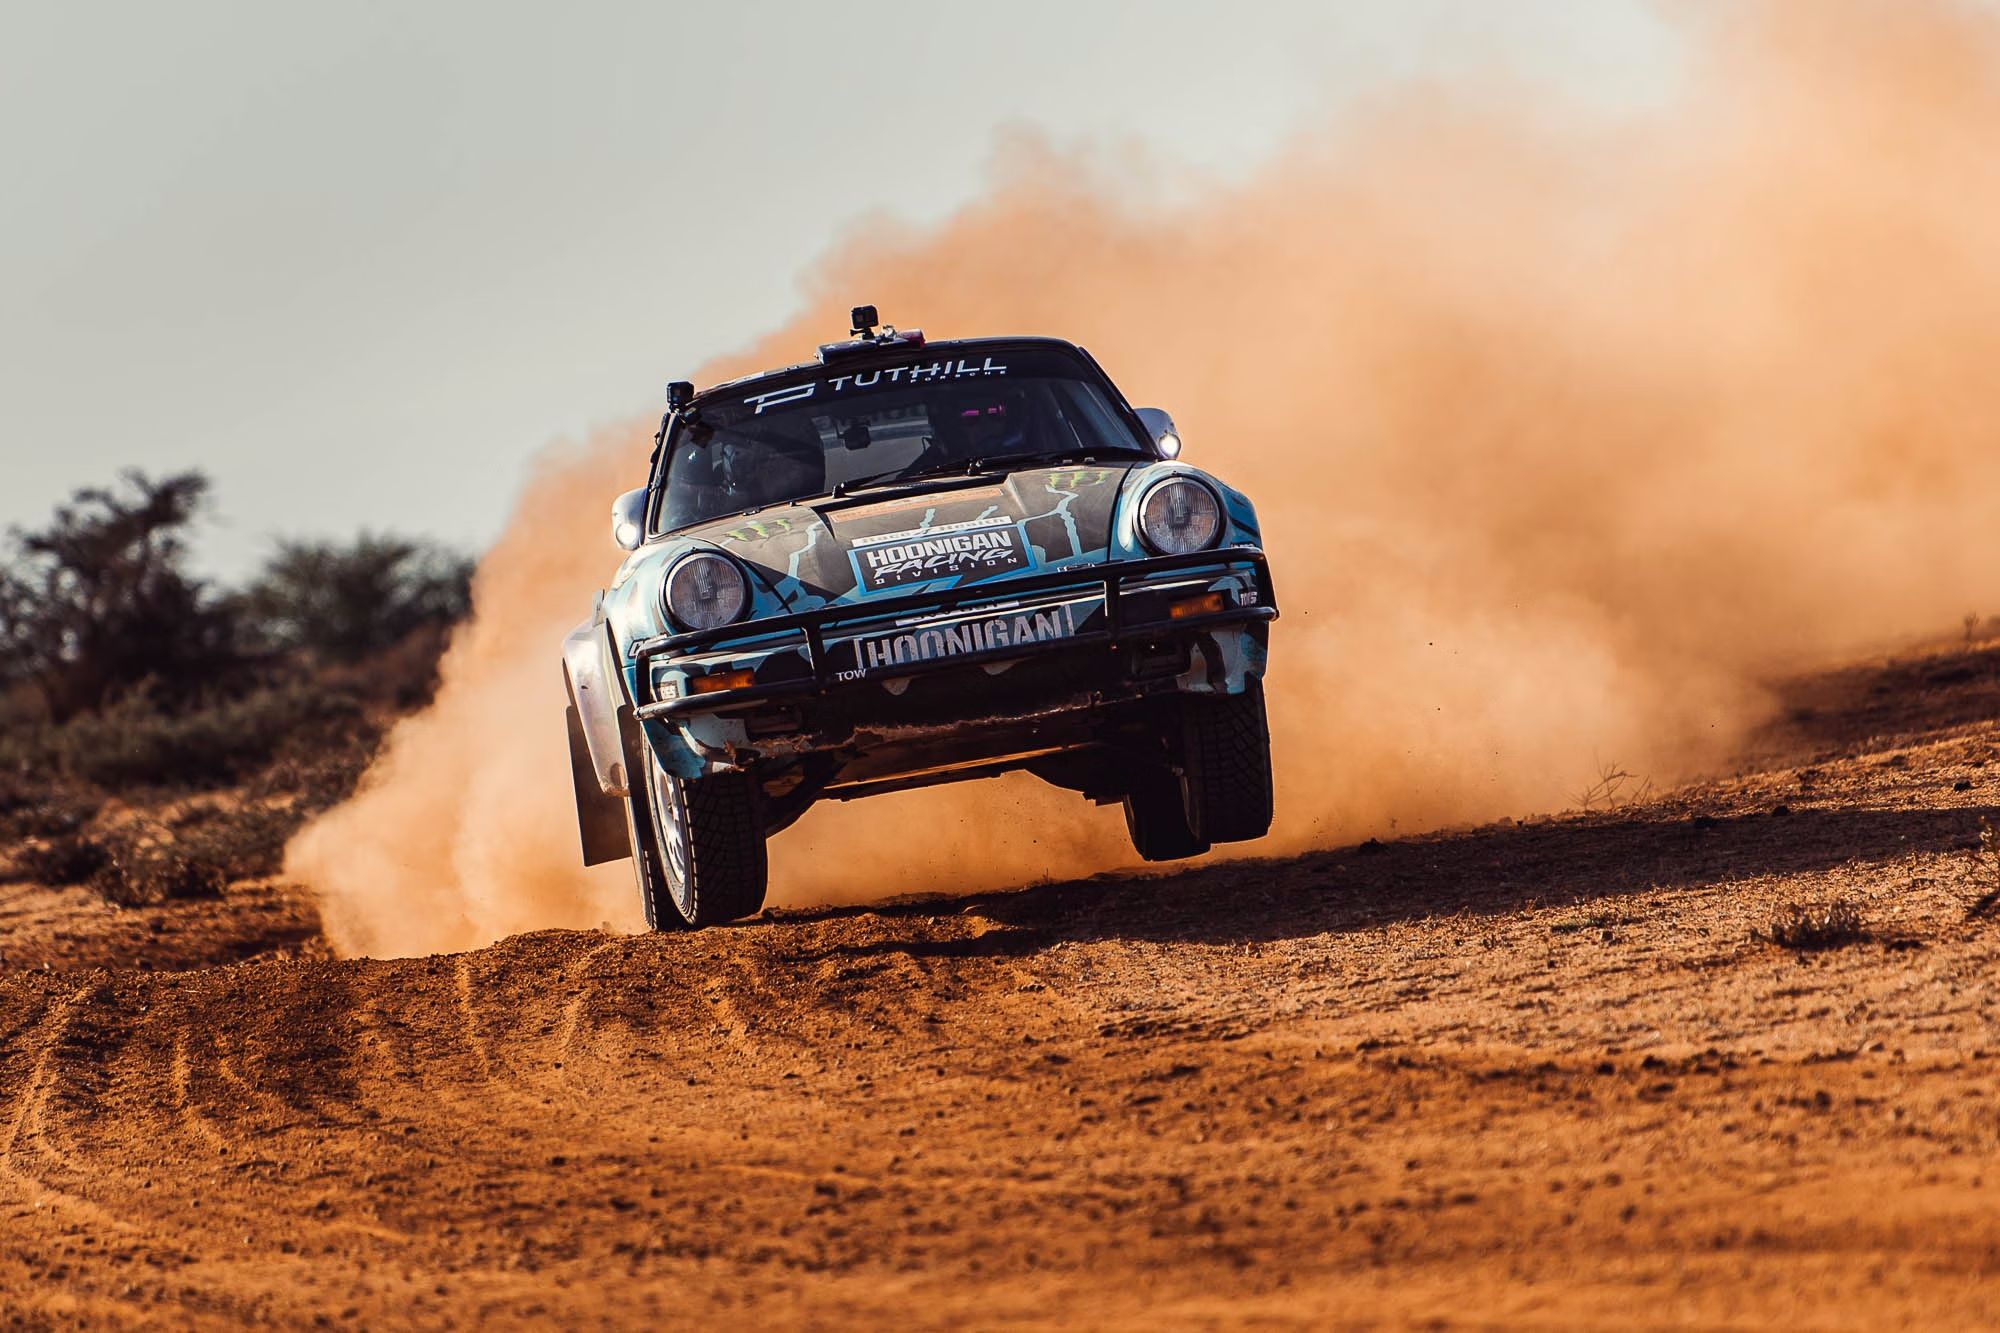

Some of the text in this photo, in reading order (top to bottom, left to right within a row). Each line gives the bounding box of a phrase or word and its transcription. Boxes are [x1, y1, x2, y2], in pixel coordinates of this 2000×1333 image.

[828, 357, 1008, 391] TUTHILL
[866, 530, 1013, 568] HOONIGAN
[873, 548, 1014, 580] RACING
[875, 557, 1018, 585] DIVISION
[836, 668, 867, 682] TOW
